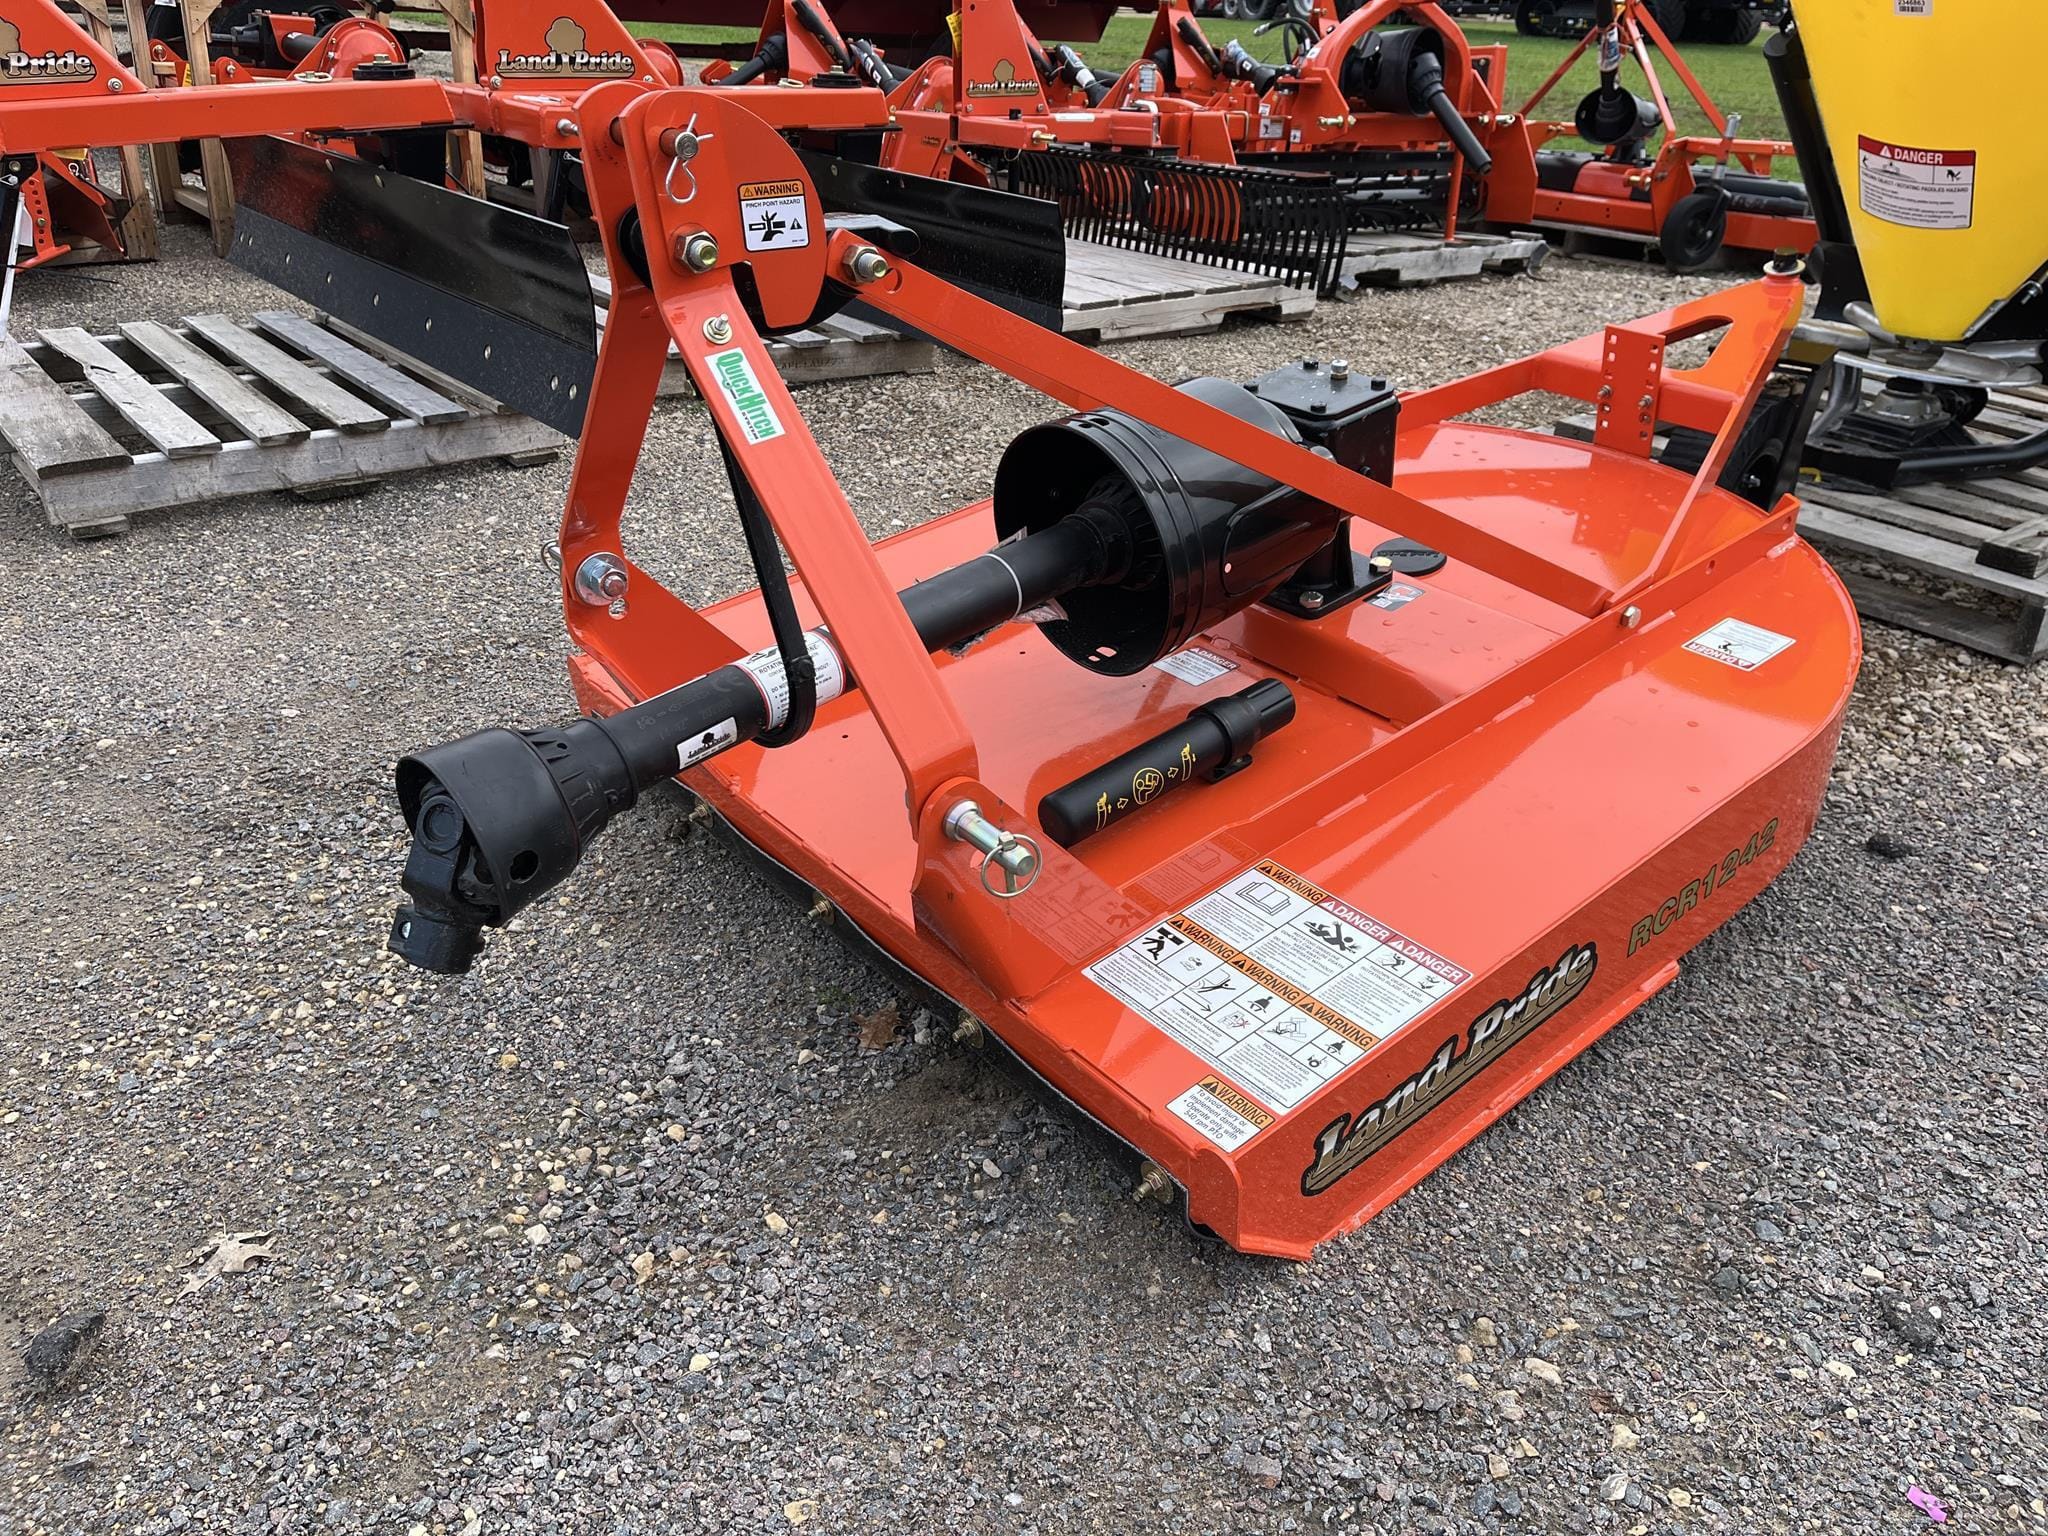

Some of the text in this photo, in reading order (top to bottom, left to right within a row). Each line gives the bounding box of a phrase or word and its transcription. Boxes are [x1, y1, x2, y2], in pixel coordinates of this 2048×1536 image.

[6, 51, 91, 75] Pride
[498, 50, 633, 71] Land Pride
[968, 80, 1039, 93] Land Pride
[1893, 148, 1943, 165] DANGER
[754, 183, 799, 196] WARNING
[1199, 650, 1237, 670] DANGER
[1688, 642, 1737, 664] DANGER
[1269, 869, 1325, 901] WARNING
[1626, 817, 1779, 958] RCR1242
[1331, 905, 1391, 940] DANGER
[1180, 923, 1236, 959] WARNING
[1402, 944, 1464, 981] DANGER
[1243, 963, 1302, 1001] WARNING
[1200, 1022, 1222, 1038] HAZARD
[1311, 1006, 1375, 1048] WARNING
[1311, 1037, 1460, 1180] Land
[1464, 942, 1598, 1066] Pride
[1184, 1101, 1238, 1140] Operate only with
[1188, 1093, 1222, 1118] implement
[1195, 1089, 1206, 1097] To
[1203, 1095, 1223, 1109] avoid
[1219, 1107, 1240, 1122] injury
[1214, 1086, 1270, 1125] WARNING
[1183, 1109, 1224, 1139] 540 rpm PTO
